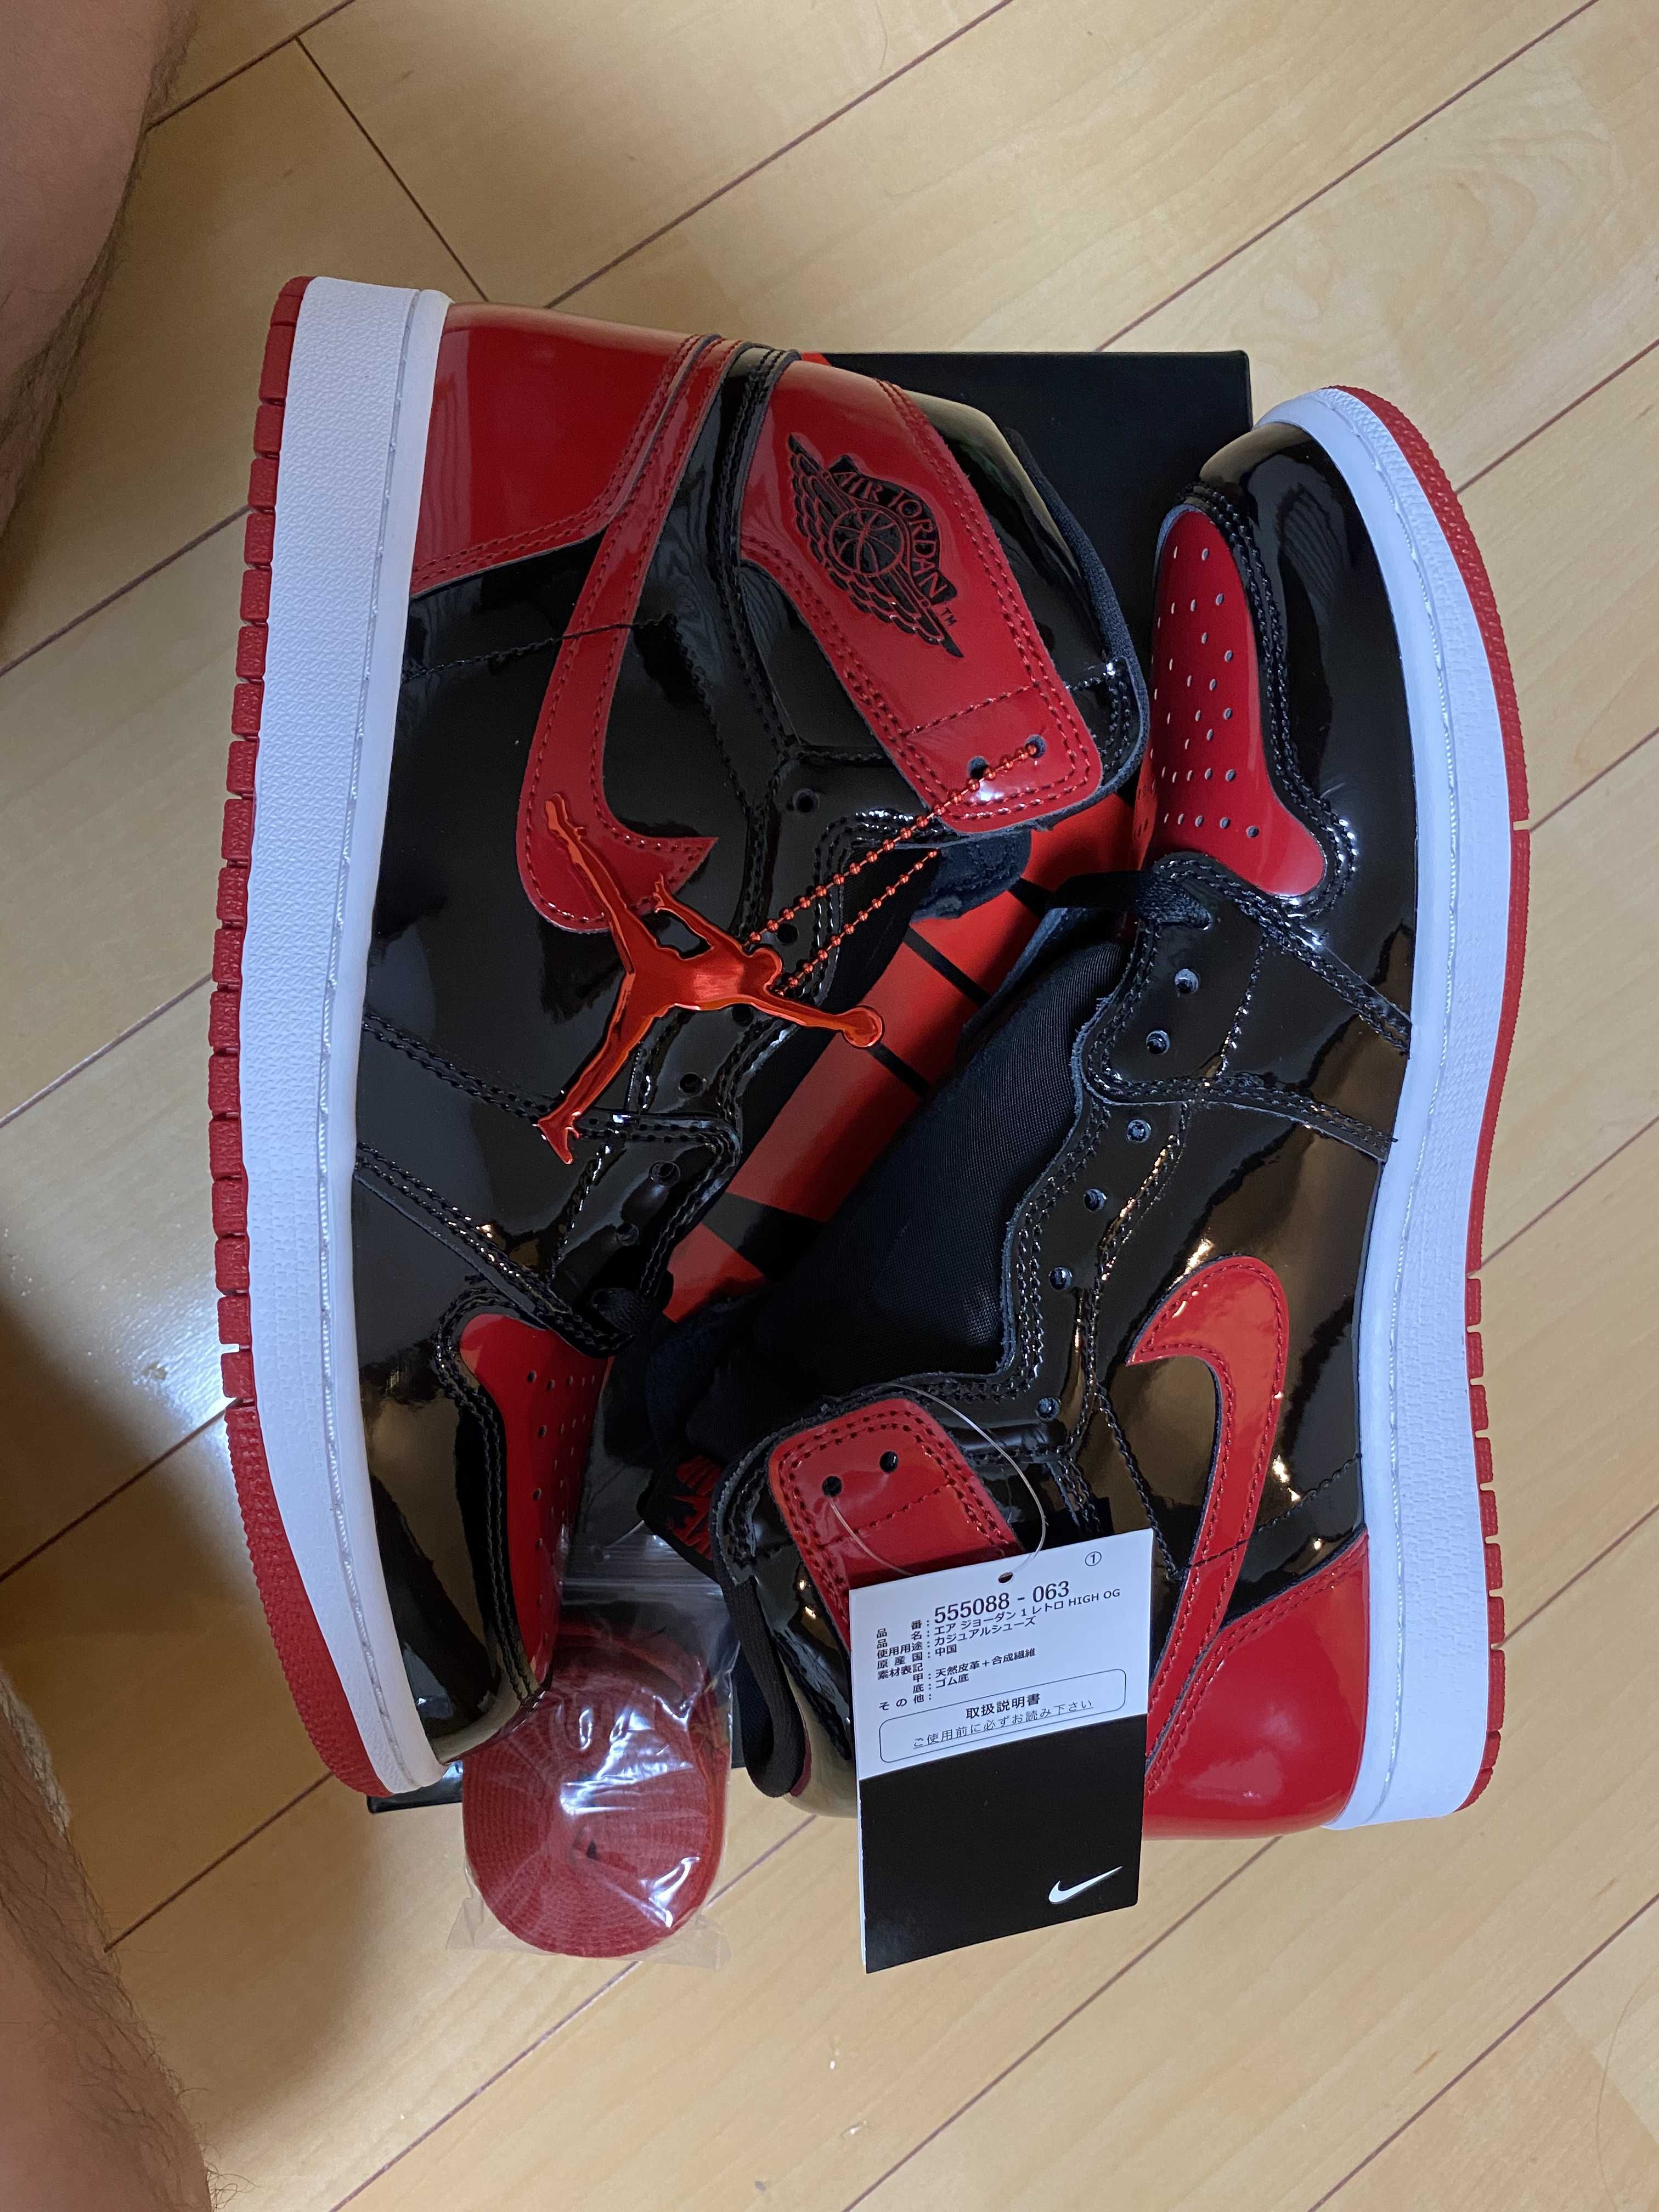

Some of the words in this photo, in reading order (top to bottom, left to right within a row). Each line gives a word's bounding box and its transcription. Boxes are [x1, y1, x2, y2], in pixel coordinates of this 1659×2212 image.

[833, 471, 883, 501] AIR
[887, 489, 948, 598] JORDAN
[934, 1592, 1010, 1624] 555088
[1032, 1580, 1069, 1603] 063
[934, 1623, 956, 1635] エア
[961, 1611, 1017, 1630] ジョーダン
[1021, 1608, 1027, 1617] 1
[1032, 1600, 1064, 1615] レトロ
[1068, 1592, 1099, 1607] HIGH
[1103, 1588, 1120, 1599] OG
[935, 1644, 957, 1657] 中国
[877, 1662, 923, 1680] 素材表記
[935, 1673, 969, 1688] ゴム底
[913, 1700, 1093, 1748] ご使用前に必ずお読み下さい
[966, 1692, 1041, 1720] 取扱説明書
